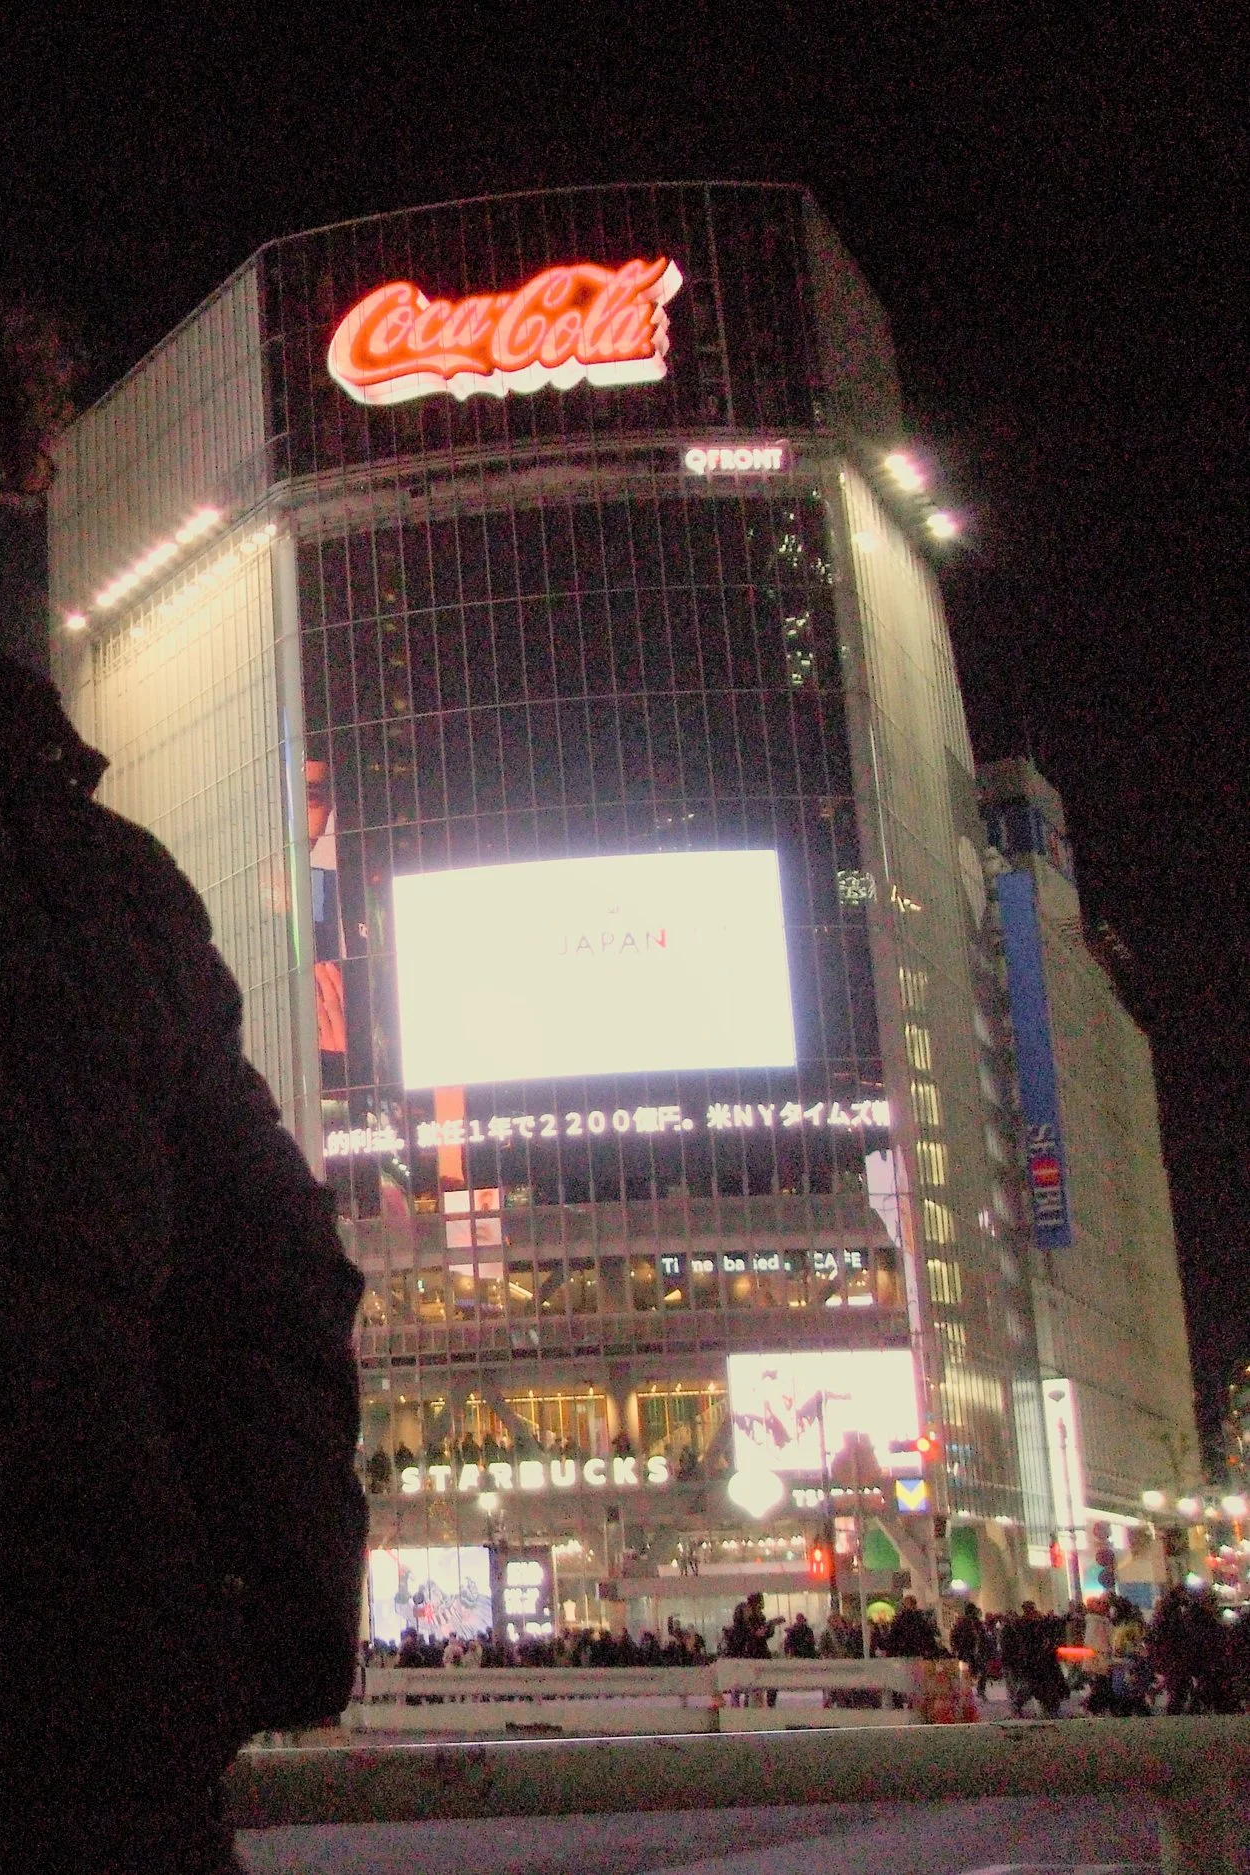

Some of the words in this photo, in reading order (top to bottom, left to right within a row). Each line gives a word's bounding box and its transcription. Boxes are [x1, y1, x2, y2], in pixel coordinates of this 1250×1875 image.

[340, 258, 664, 382] Coca-Cola
[685, 448, 783, 476] QFRONT
[401, 1456, 669, 1493] STARBUCKS
